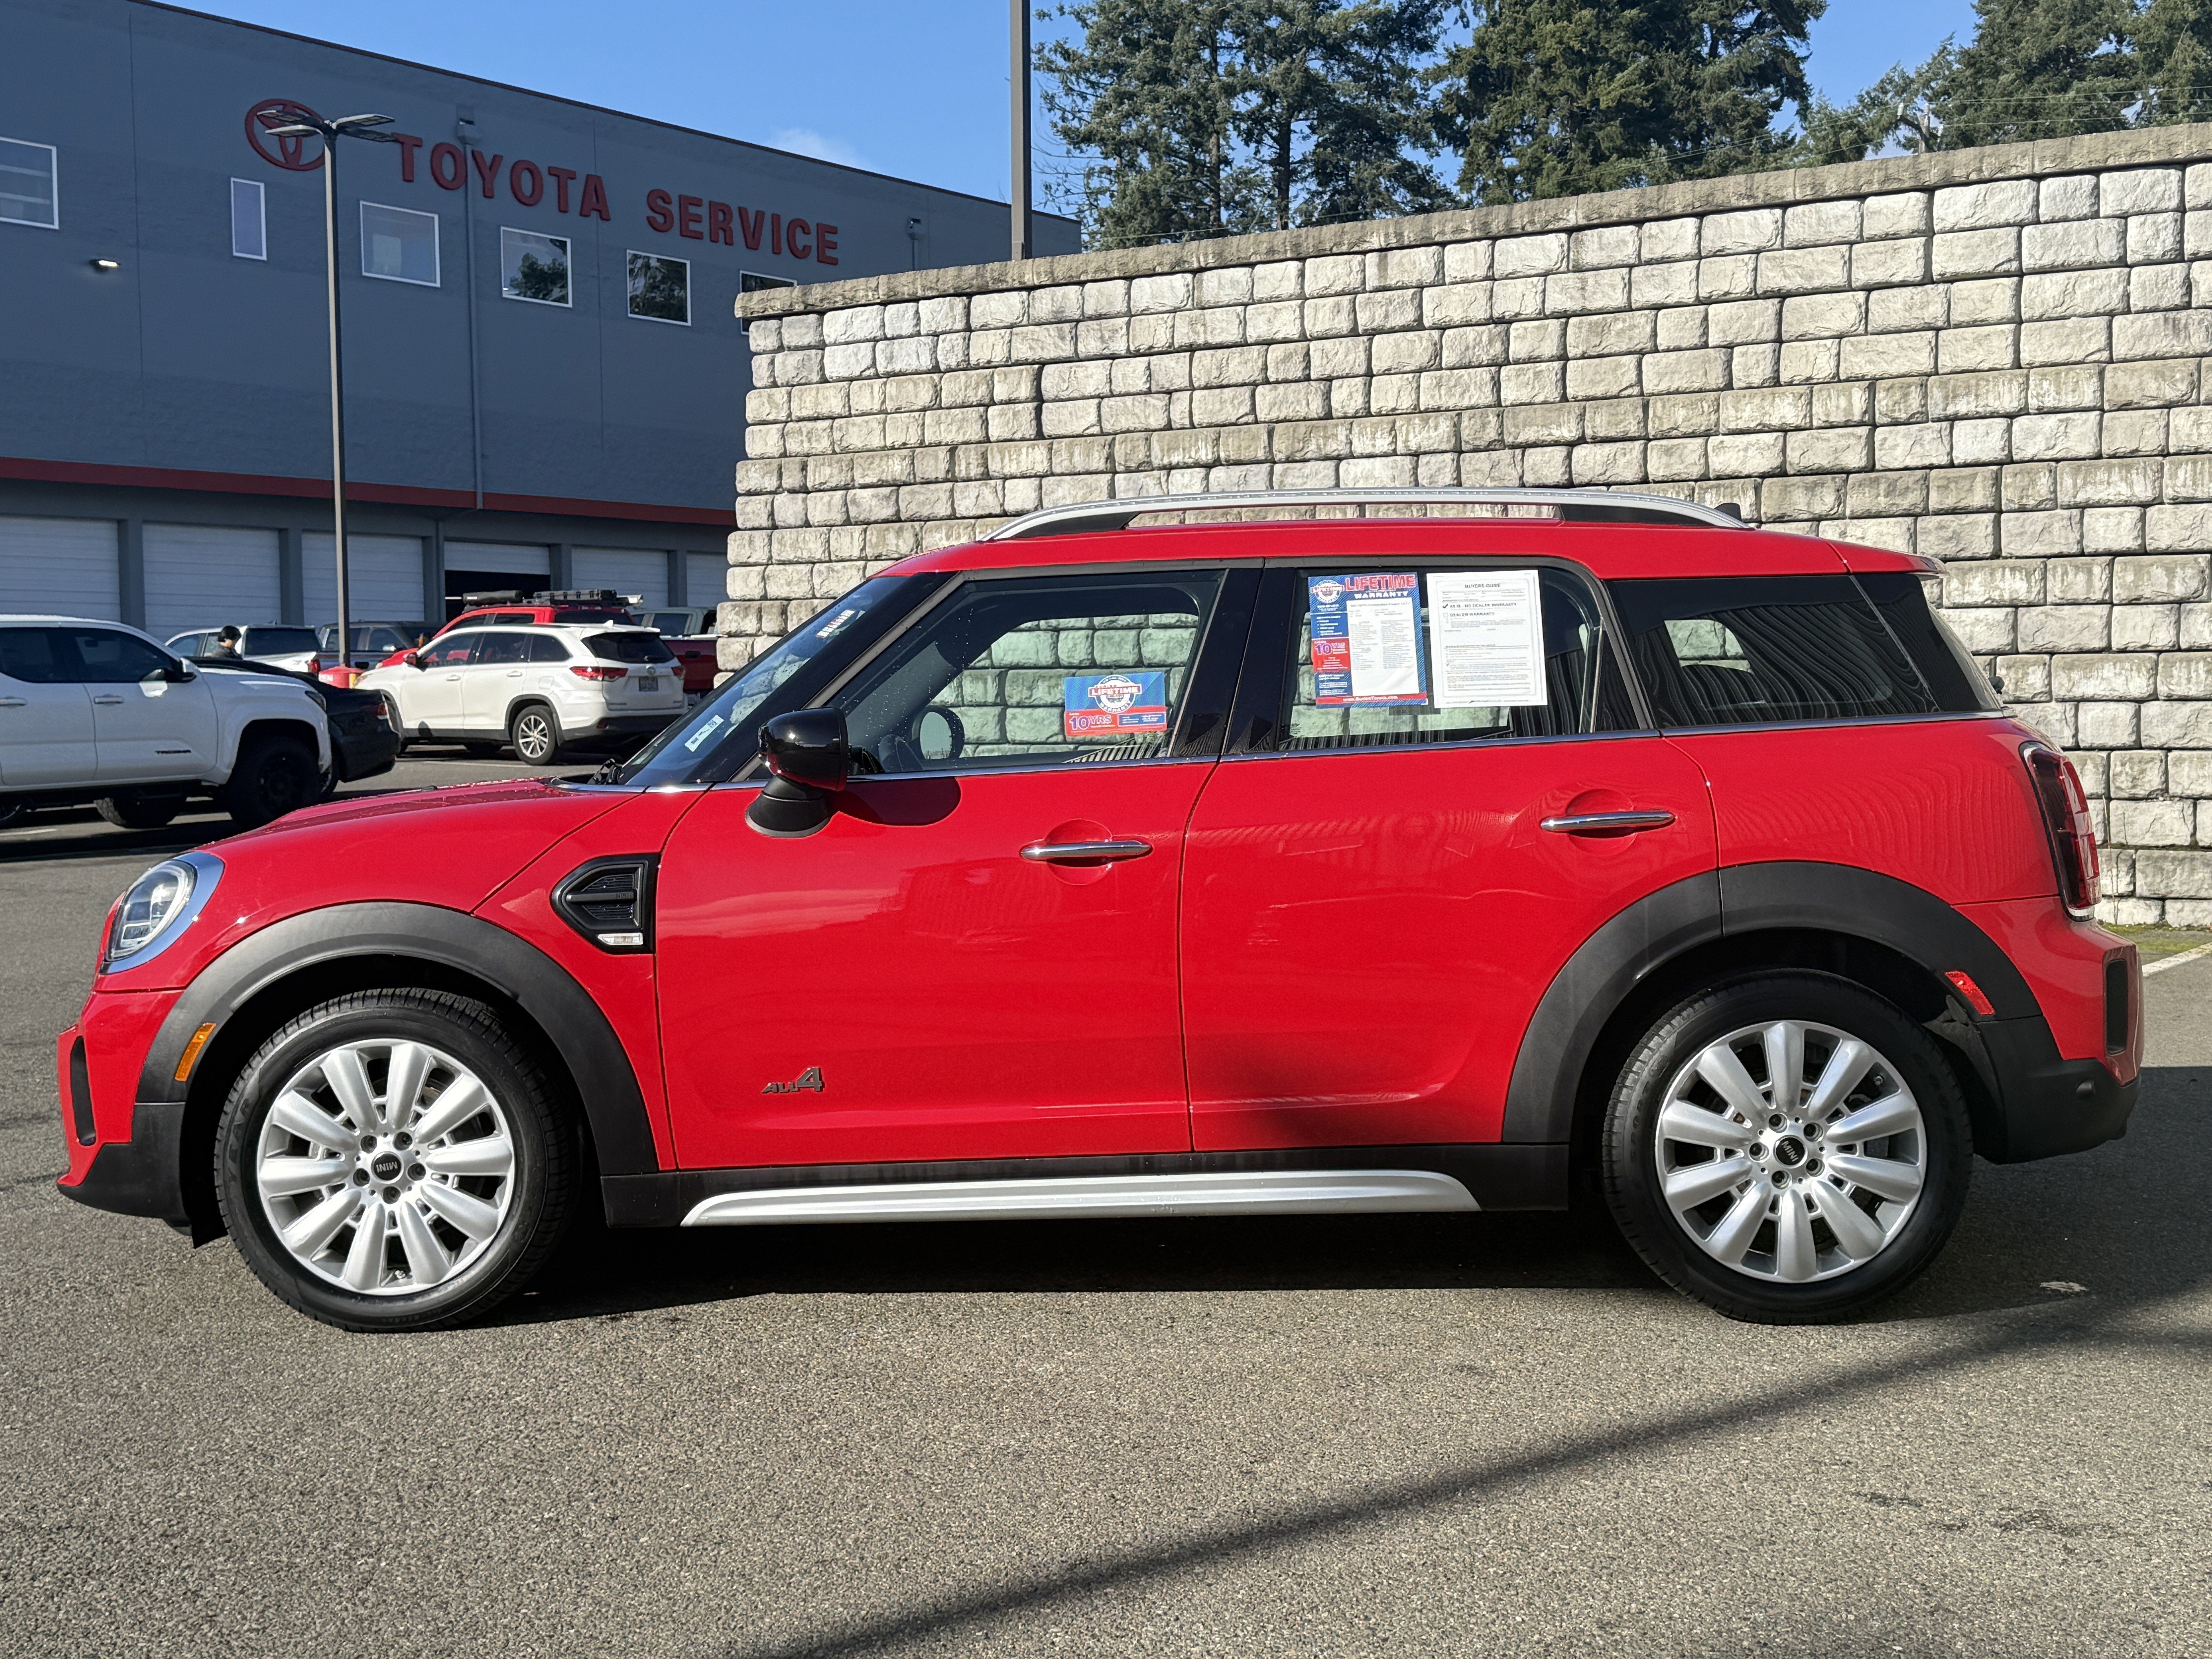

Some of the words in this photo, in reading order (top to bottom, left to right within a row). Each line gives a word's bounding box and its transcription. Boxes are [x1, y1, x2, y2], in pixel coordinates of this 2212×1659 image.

[394, 132, 611, 221] TOYOTA
[646, 189, 839, 265] SERVICE
[1345, 574, 1416, 591] LIFETIME
[1315, 643, 1332, 655] 10
[1091, 687, 1139, 696] LIFETIME
[1069, 716, 1090, 731] 10
[1089, 714, 1112, 725] YRS
[761, 1066, 823, 1093] ALL4
[1781, 1141, 1799, 1162] MINI
[376, 1161, 398, 1173] MINI
